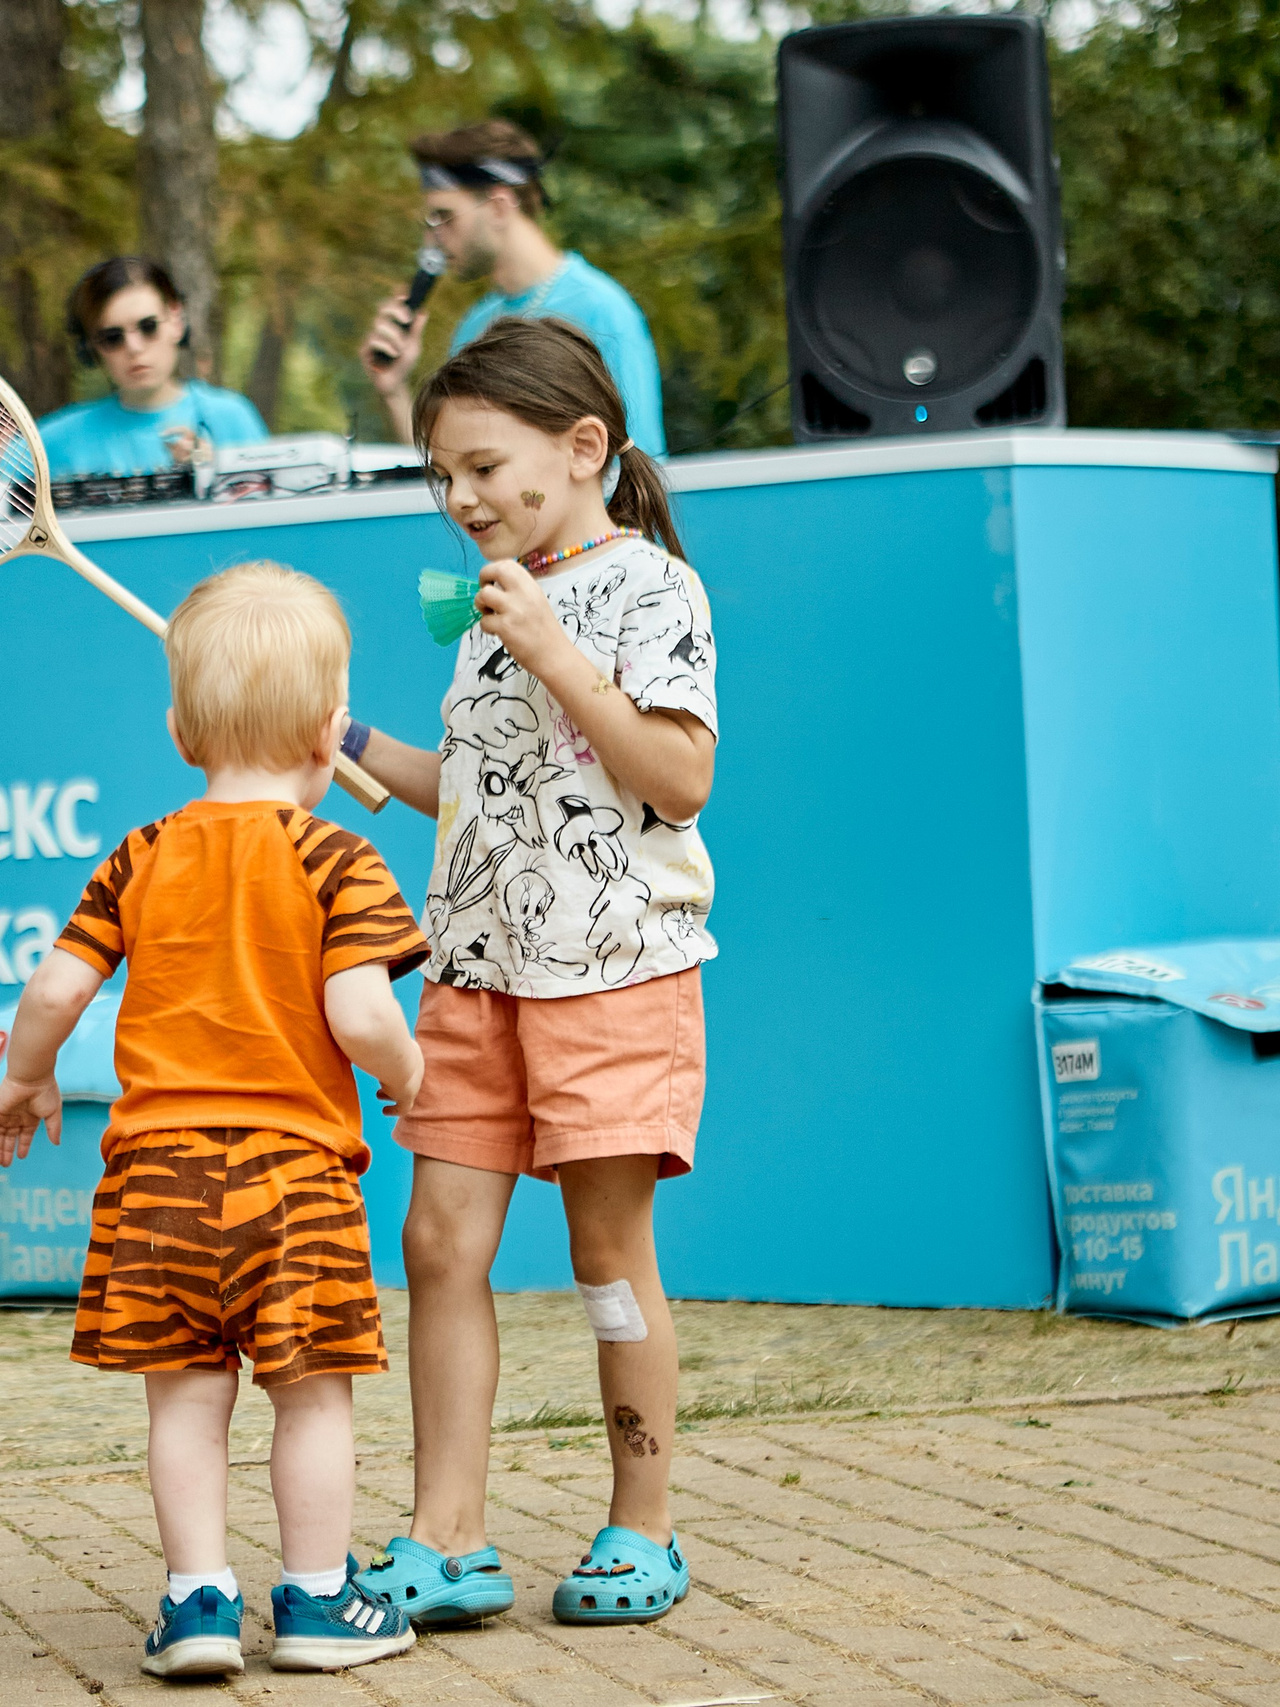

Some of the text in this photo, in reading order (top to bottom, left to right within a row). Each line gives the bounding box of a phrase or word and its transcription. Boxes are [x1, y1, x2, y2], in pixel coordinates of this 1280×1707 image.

[1211, 1165, 1280, 1226] Ян
[1065, 1211, 1177, 1237] родуктов
[1070, 1270, 1128, 1295] инут
